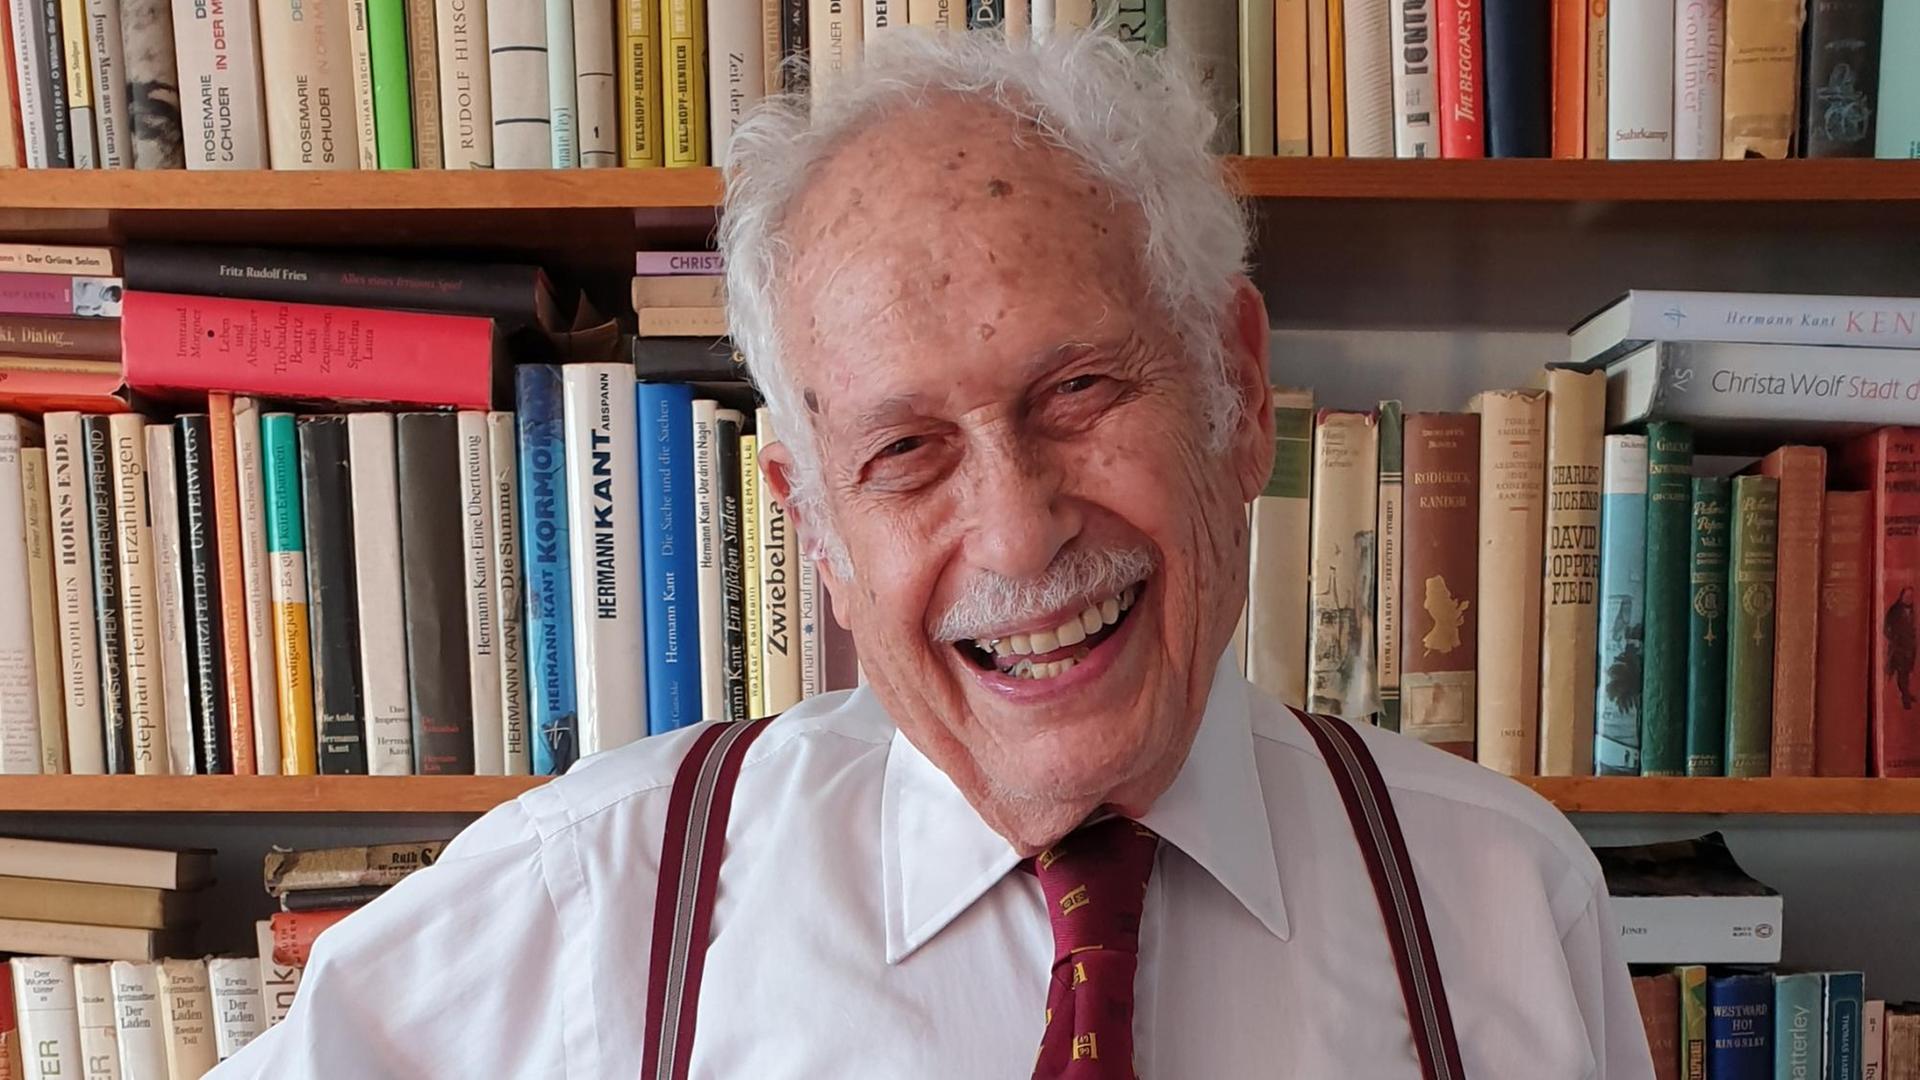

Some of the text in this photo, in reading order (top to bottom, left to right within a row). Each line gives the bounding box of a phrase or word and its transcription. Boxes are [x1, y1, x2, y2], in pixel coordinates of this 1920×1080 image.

[214, 19, 227, 72] IN DER
[1684, 3, 1707, 112] Gordimer
[1706, 3, 1724, 84] Nadine
[71, 40, 83, 98] Armin Stolper
[93, 13, 117, 153] Junger Mann aus gutem
[359, 51, 370, 95] KUSCHE
[451, 0, 475, 150] RUDOLF HIRSC
[729, 52, 744, 83] Zeit
[1454, 11, 1475, 122] THE BEGGAR'S
[53, 83, 65, 132] Stolper
[634, 43, 645, 152] WELSKOPF-HENRICH
[730, 83, 744, 115] der
[201, 74, 216, 164] ROSEMARIE
[297, 75, 313, 164] ROSEMARIE
[319, 87, 335, 164] SCHUDER
[362, 99, 374, 143] LOTHAR
[1615, 128, 1669, 142] Suhrkamp
[26, 254, 43, 264] Der
[45, 255, 73, 265] Grüne
[220, 265, 307, 281] Fritz Rudolf Fries
[177, 307, 187, 358] Irmtraud
[191, 309, 204, 359] Morgner
[219, 318, 230, 353] Leben
[234, 324, 245, 348] und
[247, 308, 259, 367] Abenteuer
[261, 328, 273, 348] der
[1726, 311, 1915, 335] Hermann Kant KEN
[274, 306, 289, 375] Trobadora
[289, 317, 304, 365] Beatriz
[308, 328, 318, 354] nach
[334, 329, 346, 357] ihrer
[347, 320, 361, 370] Spielfrau
[362, 328, 374, 361] Laura
[1711, 370, 1902, 400] Christa Wolf Stadt
[696, 421, 711, 449] Nagel
[90, 428, 107, 493] FREUND
[697, 451, 710, 479] dritte
[1552, 466, 1600, 485] CHARLES
[184, 427, 204, 550] UNTERWEGS
[276, 445, 287, 510] Erbarmen
[1414, 472, 1471, 485] RODERICK
[592, 373, 618, 619] HERMANN KANT ABSPANN
[698, 501, 710, 524] Kant
[1419, 497, 1466, 508] RANDOM
[1551, 491, 1599, 511] DICKENS
[30, 500, 41, 530] Müller
[278, 511, 289, 542] kein
[500, 482, 514, 556] Summe
[657, 399, 678, 664] Hermann Kant Die Sache und die Sachen
[724, 496, 739, 543] Südsee
[33, 532, 43, 559] Heiner
[467, 435, 491, 656] Hermann Kant Eine Übertretung
[700, 525, 713, 568] Hermann
[1551, 525, 1596, 550] DAVID
[53, 433, 85, 707] CHRISTOPH HEIN HORNS ENDE
[103, 563, 116, 597] DER
[281, 571, 293, 588] Es
[501, 558, 514, 591] Die
[1548, 555, 1600, 578] OPPER
[118, 436, 157, 762] Stephan Hermlin Erzählungen
[542, 570, 556, 618] KANT
[1551, 582, 1593, 605] FIELD
[103, 608, 118, 644] HEIN
[193, 562, 212, 674] HERZFELDE
[728, 604, 742, 632] Ein
[1384, 595, 1393, 631] HARDY
[544, 624, 561, 712] HERMANN
[729, 647, 744, 682] Kant
[1384, 634, 1393, 676] THOMAS
[335, 713, 354, 721] Aula
[507, 666, 521, 754] HERMANN
[328, 744, 349, 752] Kant
[392, 852, 418, 864] Ruth
[33, 970, 50, 978] Der
[120, 984, 143, 992] Erwin
[172, 975, 194, 985] Erwin
[225, 977, 247, 987] Erwin
[125, 1005, 143, 1017] Der
[171, 1009, 203, 1021] Laden
[177, 997, 195, 1009] Der
[224, 1012, 255, 1023] Laden
[229, 1000, 248, 1011] Der
[1713, 1004, 1768, 1018] WESTWARD
[121, 1015, 151, 1028] Laden
[1732, 1019, 1753, 1031] HO!
[1841, 1015, 1850, 1053] THOMAS
[1715, 1037, 1765, 1049] KINGSLEY
